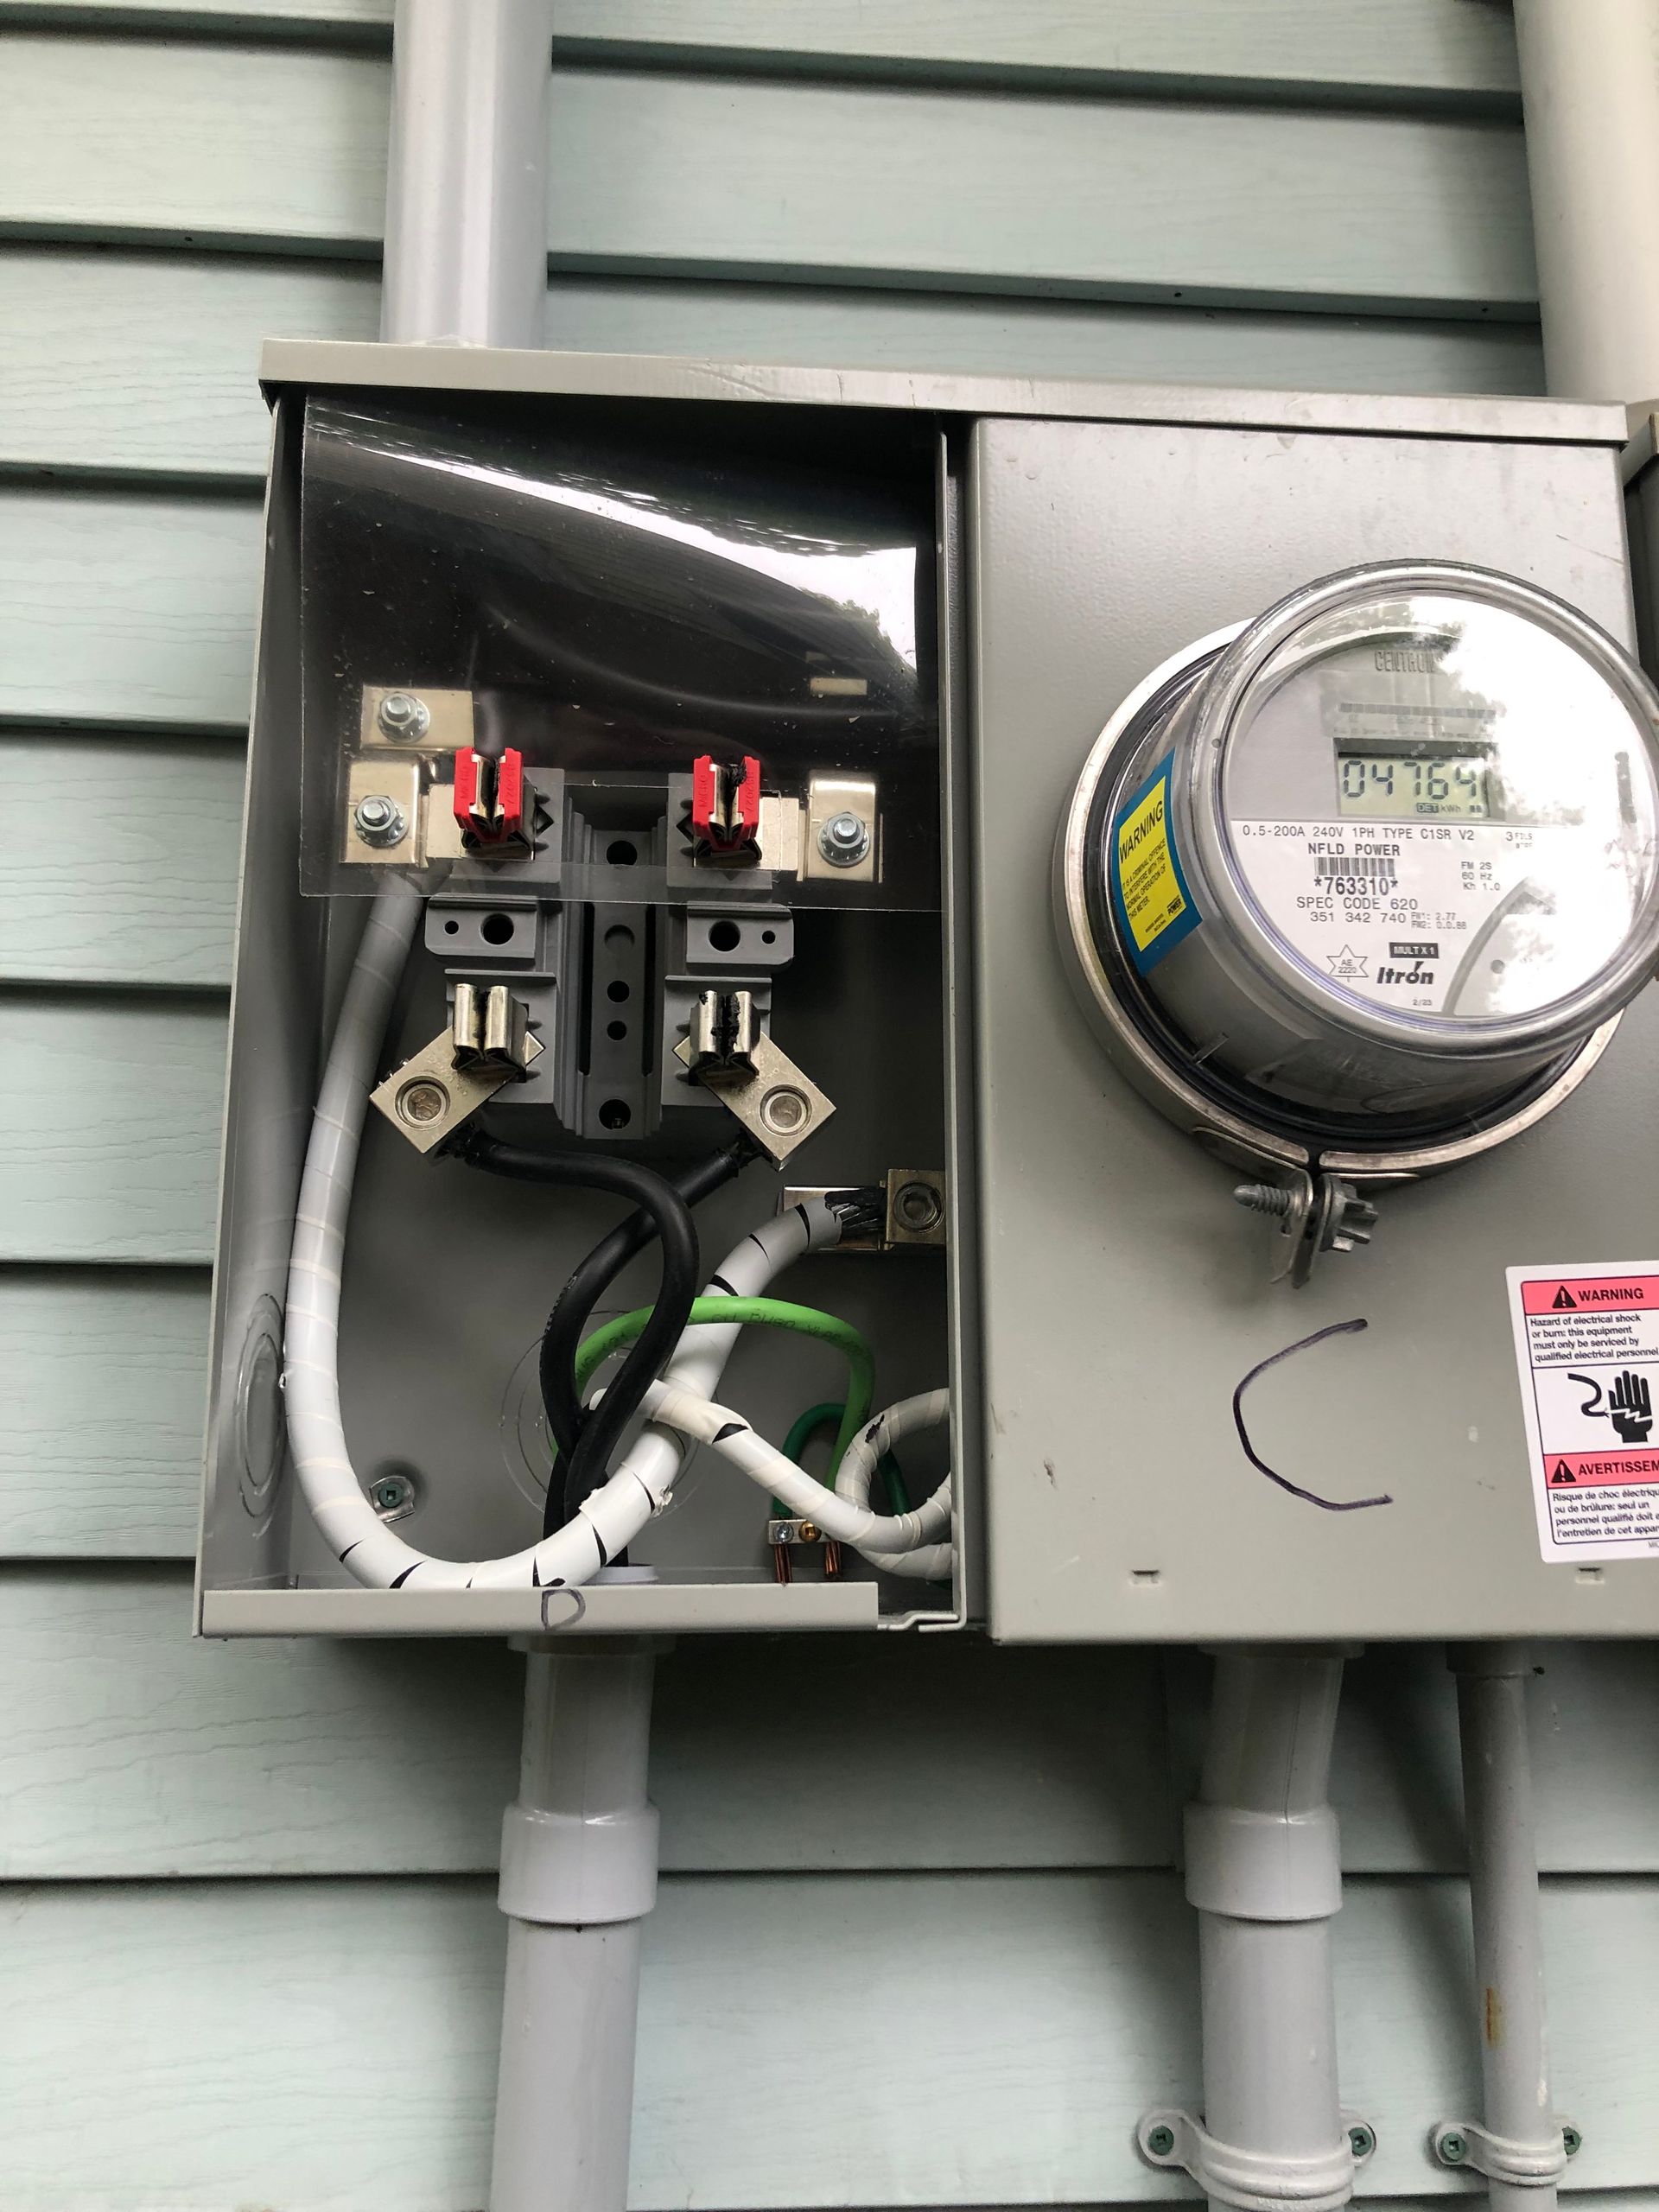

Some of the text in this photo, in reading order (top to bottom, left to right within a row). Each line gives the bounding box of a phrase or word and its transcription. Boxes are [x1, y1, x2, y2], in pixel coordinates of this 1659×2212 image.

[1120, 800, 1164, 864] WARNING
[1243, 824, 1475, 841] 0.5-200A 240V 1PH TYPE C1SR V2
[1506, 831, 1513, 842] 3
[1308, 842, 1401, 856] NFLD POWER
[1483, 882, 1501, 891] 1.0
[1297, 897, 1418, 910] SPEC CODE 620
[1310, 912, 1406, 924] 351 342 740
[1578, 1287, 1644, 1301] WARNING
[1530, 1313, 1641, 1327] Hazard of electrical shock
[1543, 1329, 1566, 1338] burn:
[1568, 1328, 1584, 1337] this
[1586, 1325, 1632, 1337] equipment
[1533, 1341, 1555, 1350] must
[1557, 1340, 1574, 1351] only
[1591, 1338, 1626, 1346] serviced
[1629, 1337, 1639, 1346] by
[1535, 1351, 1572, 1363] qualified
[1574, 1349, 1614, 1360] electrical
[1233, 1319, 1393, 1510] C
[1553, 1492, 1583, 1503] Risque
[1586, 1491, 1596, 1500] de
[1599, 1491, 1619, 1499] choc
[1581, 1503, 1615, 1513] brûlure:
[1618, 1501, 1636, 1510] seul
[1555, 1515, 1599, 1527] personnel
[1602, 1513, 1634, 1524] qualifié
[1637, 1512, 1653, 1521] doit
[1556, 1529, 1602, 1538] l'entretien
[1618, 1526, 1631, 1535] cet
[541, 1588, 586, 1631] D
